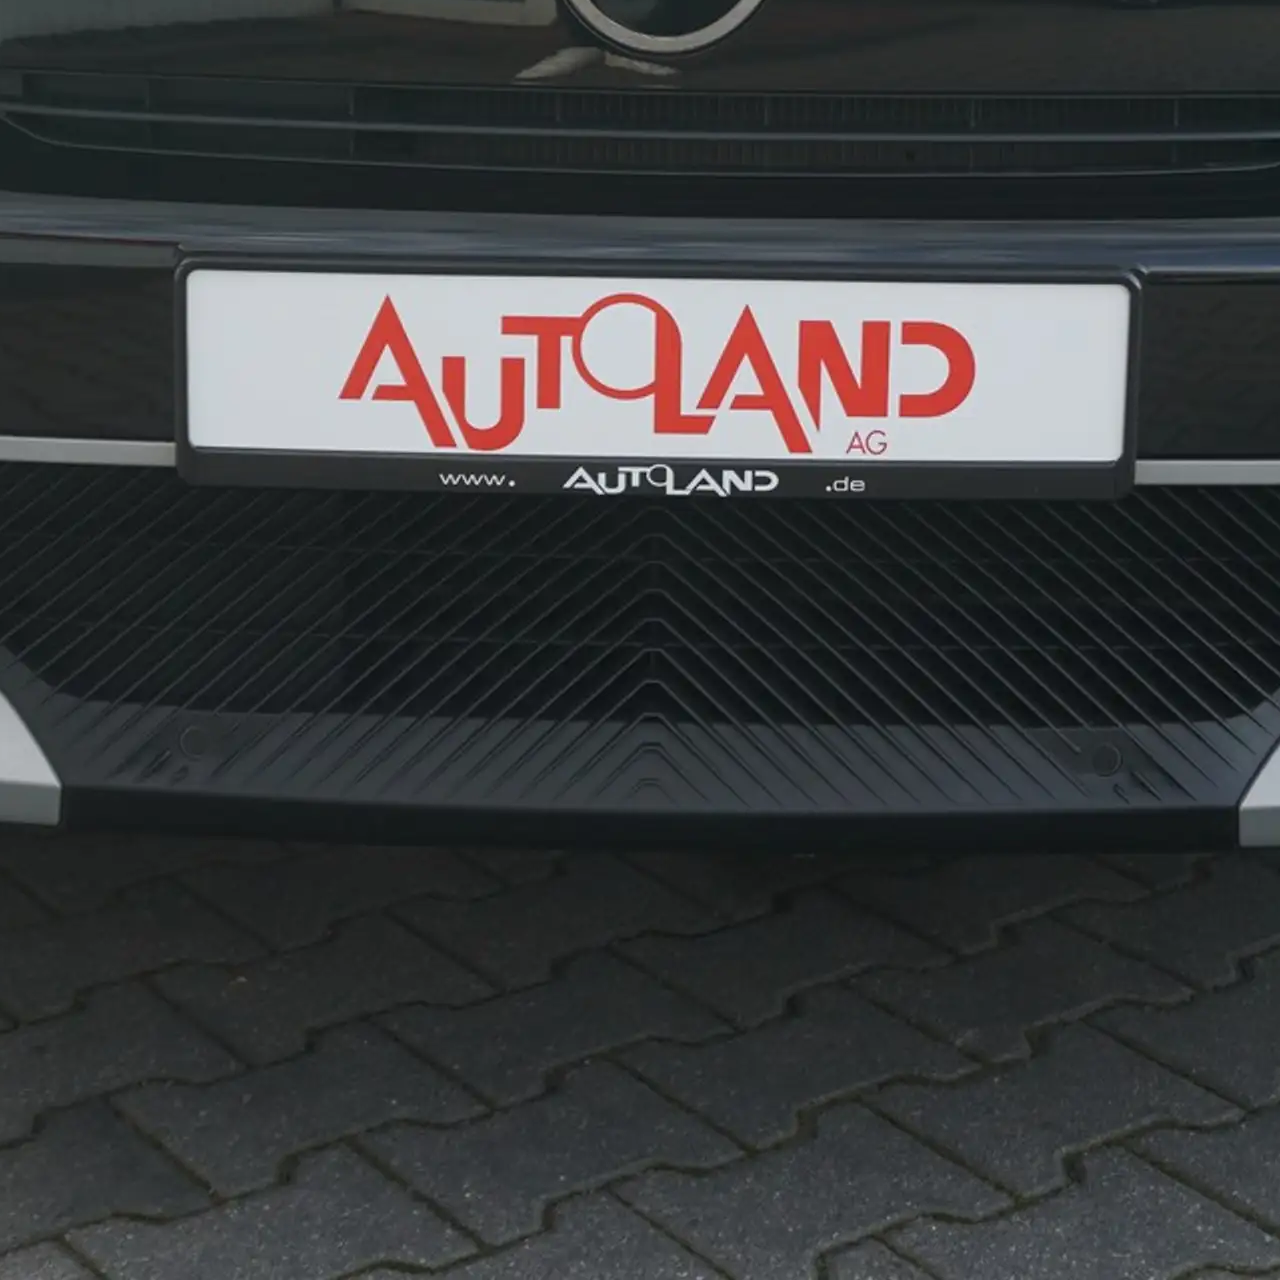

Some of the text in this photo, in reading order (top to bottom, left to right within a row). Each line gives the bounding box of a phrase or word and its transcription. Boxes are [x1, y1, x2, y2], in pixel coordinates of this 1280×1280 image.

[846, 430, 888, 455] AG
[439, 464, 866, 497] www. AUTOLAND .de
